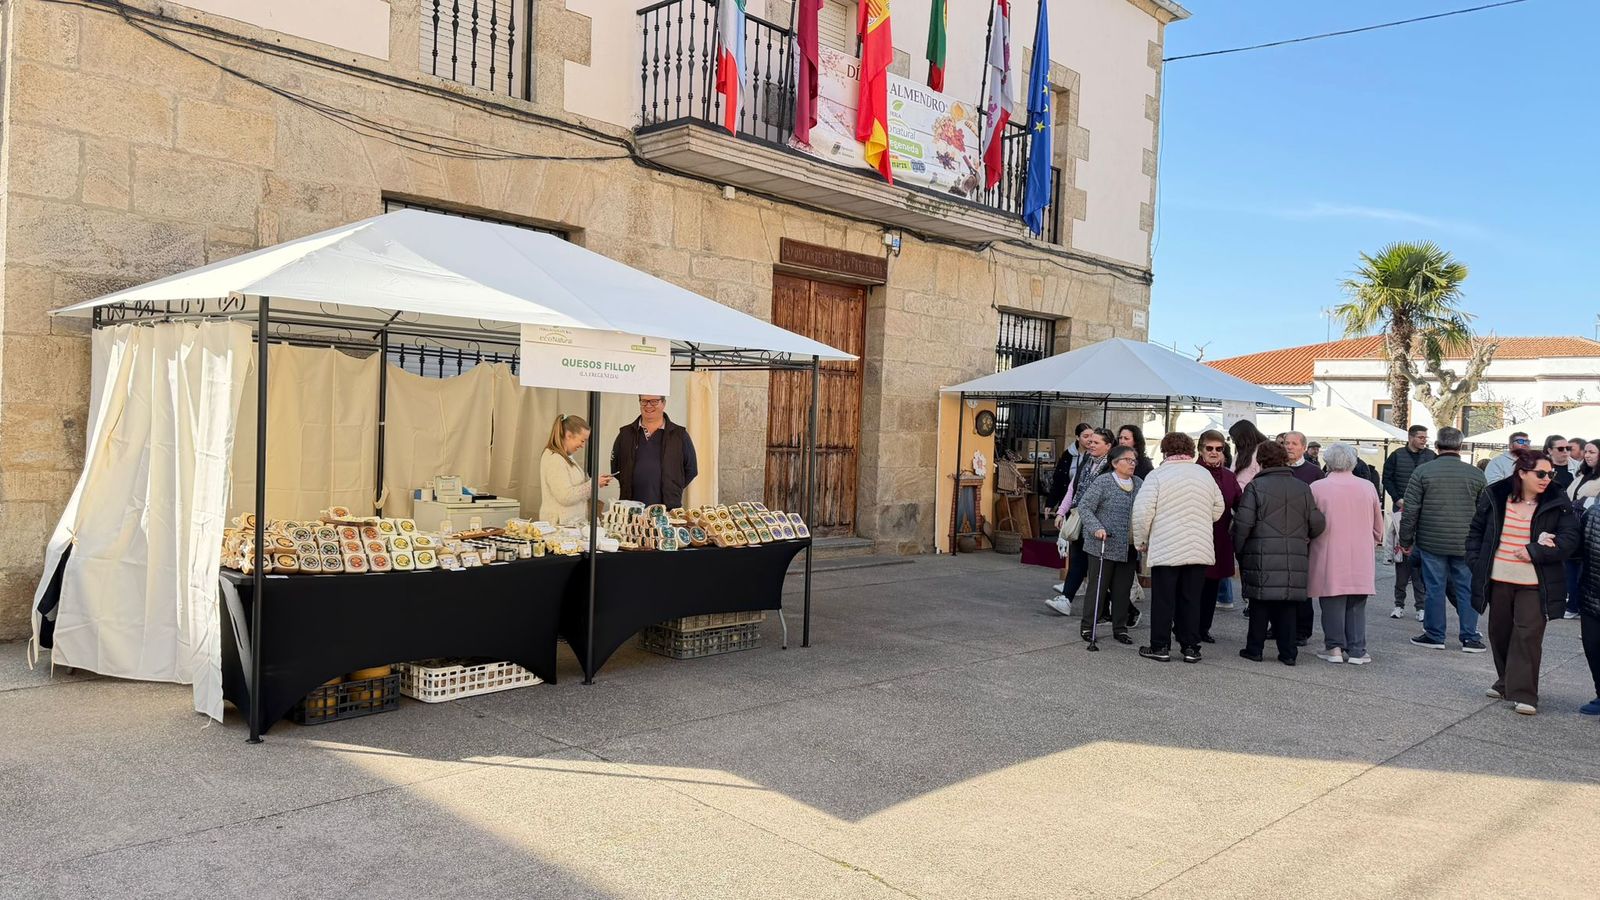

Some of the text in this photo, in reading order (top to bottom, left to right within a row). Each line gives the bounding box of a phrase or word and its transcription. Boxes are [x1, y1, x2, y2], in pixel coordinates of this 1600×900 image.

[847, 64, 946, 113] DÍ ALMENDRO
[561, 358, 636, 373] QUESOS FILLOY
